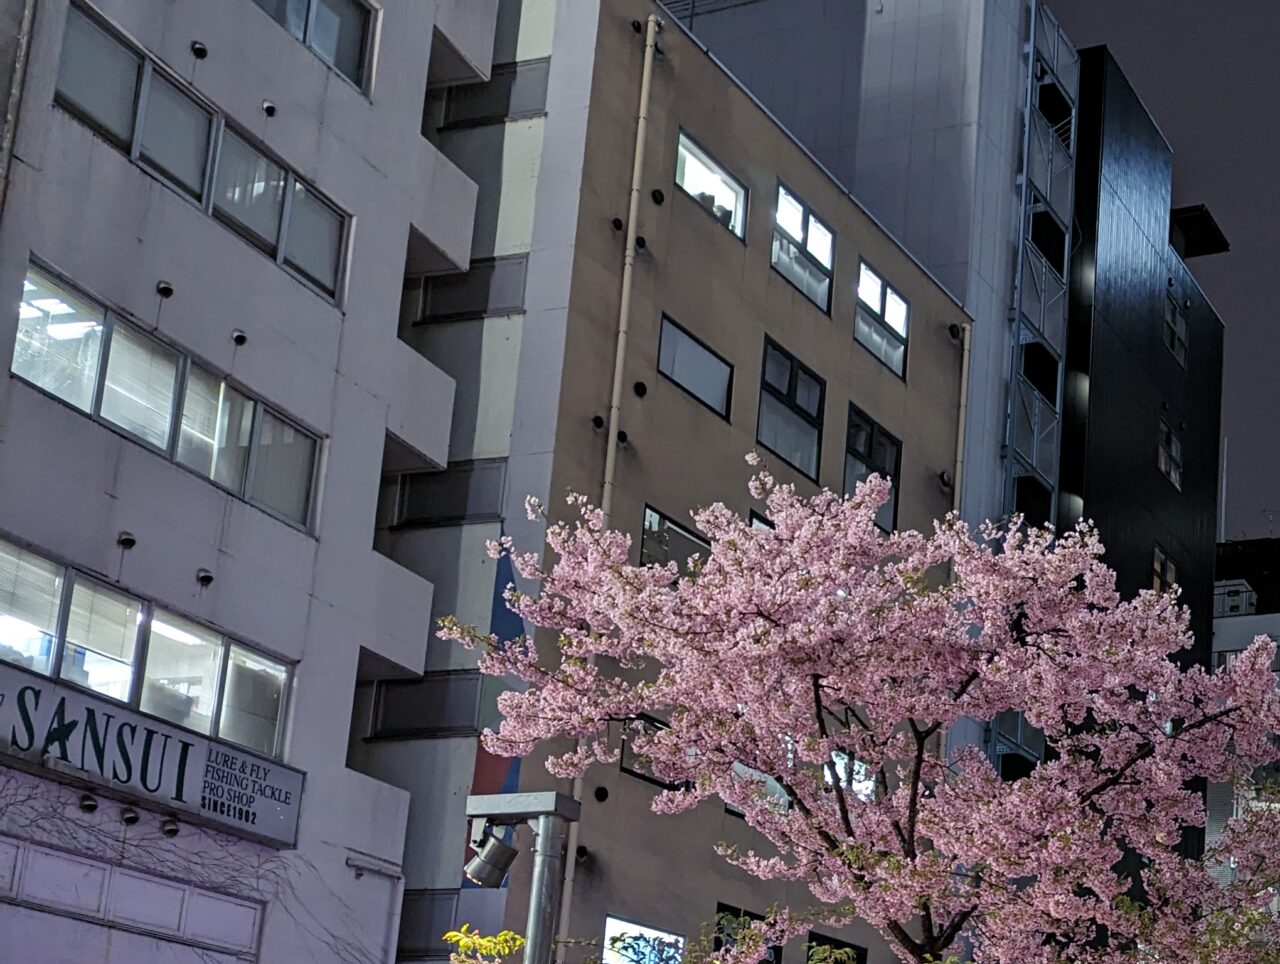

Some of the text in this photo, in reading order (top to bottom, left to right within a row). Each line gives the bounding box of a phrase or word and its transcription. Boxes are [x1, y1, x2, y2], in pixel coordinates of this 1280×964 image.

[10, 685, 195, 804] SANSUI
[204, 763, 292, 805] FISHING TACKLE
[207, 748, 271, 782] LURE & FLY
[202, 780, 256, 809] PRO SHOP
